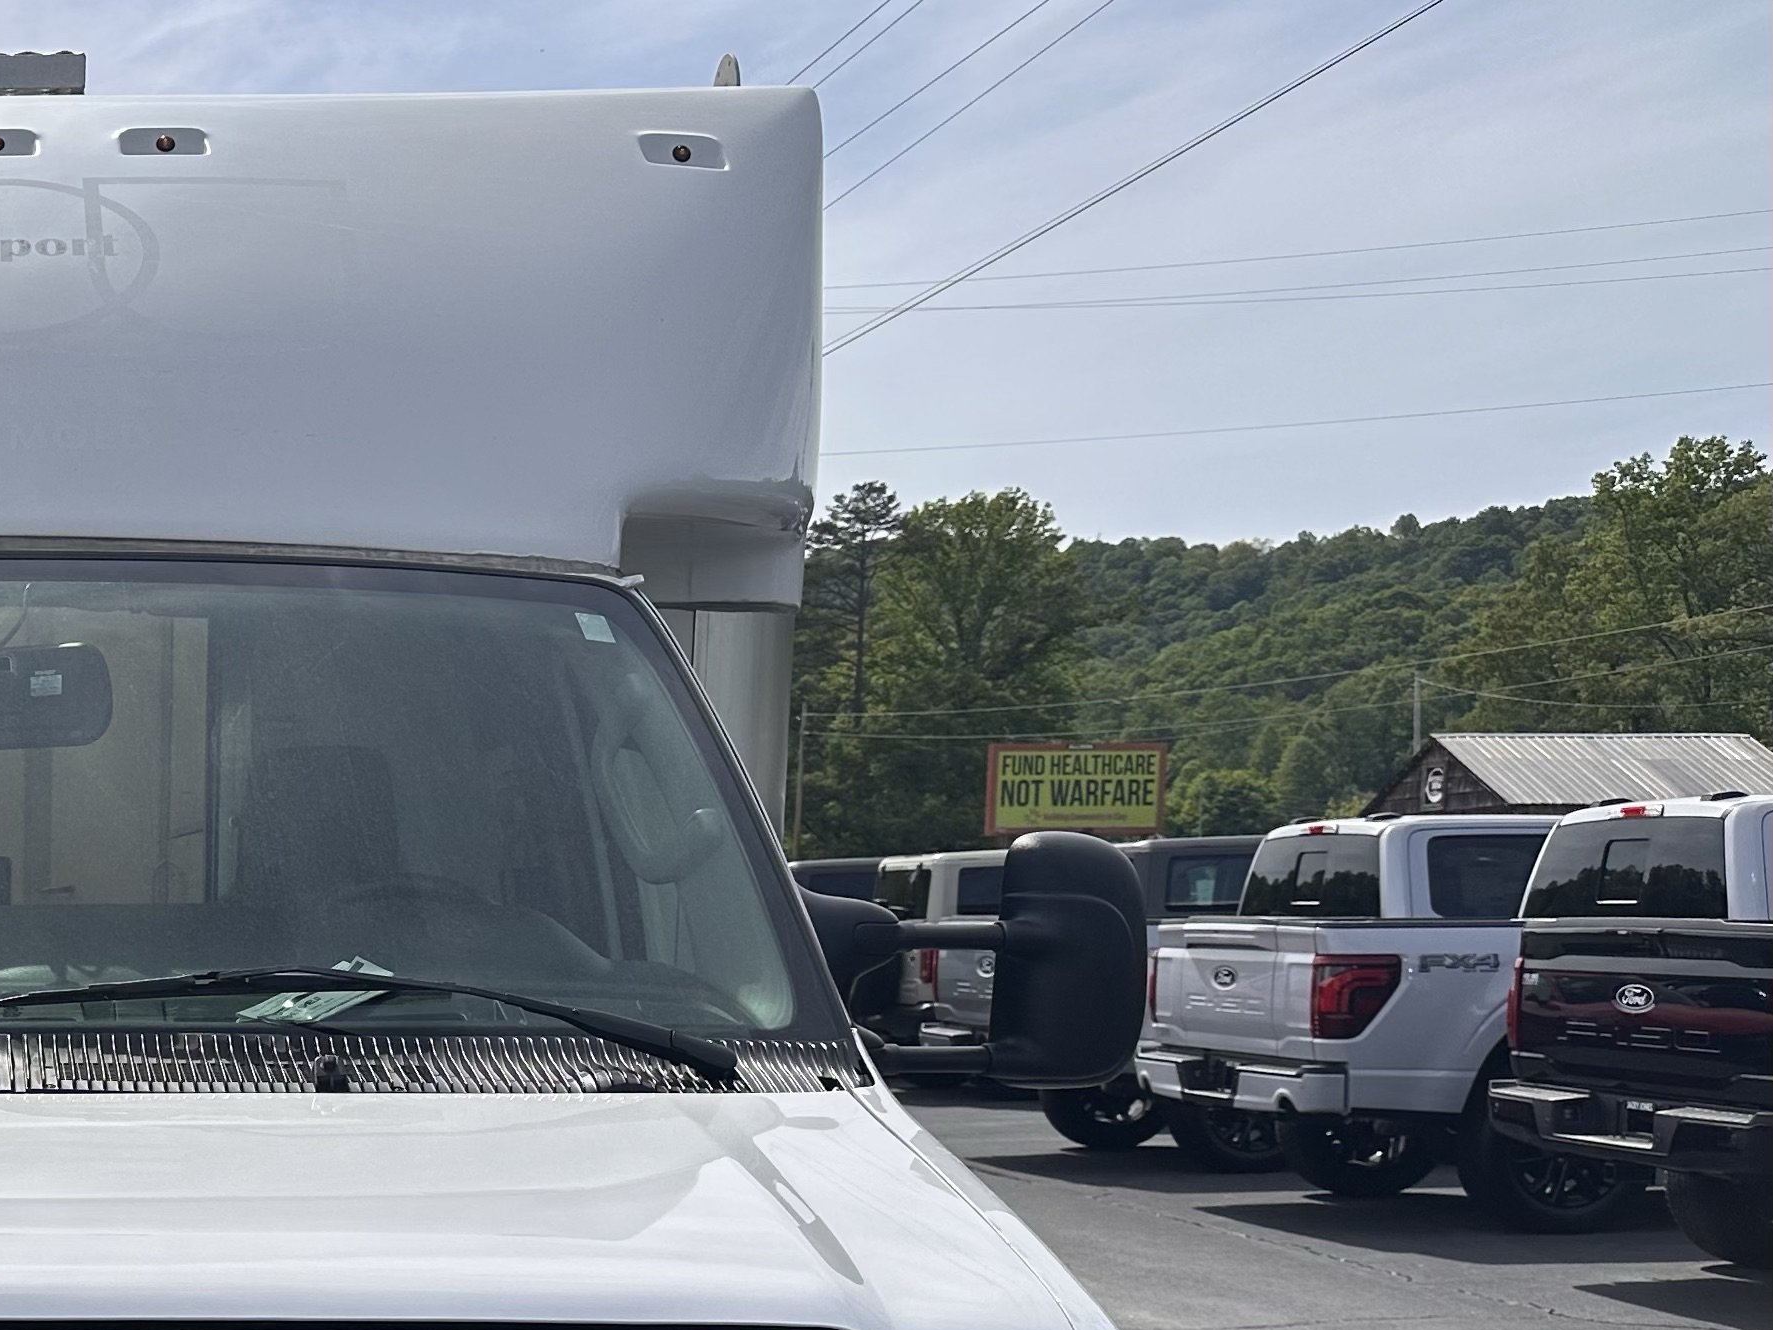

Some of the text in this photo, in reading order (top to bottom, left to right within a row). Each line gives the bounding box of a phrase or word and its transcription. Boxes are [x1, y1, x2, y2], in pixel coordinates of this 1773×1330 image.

[1002, 754, 1157, 776] FUND HEALTHCARE
[1000, 779, 1155, 807] NOT WARFARE
[1418, 953, 1500, 973] FX4
